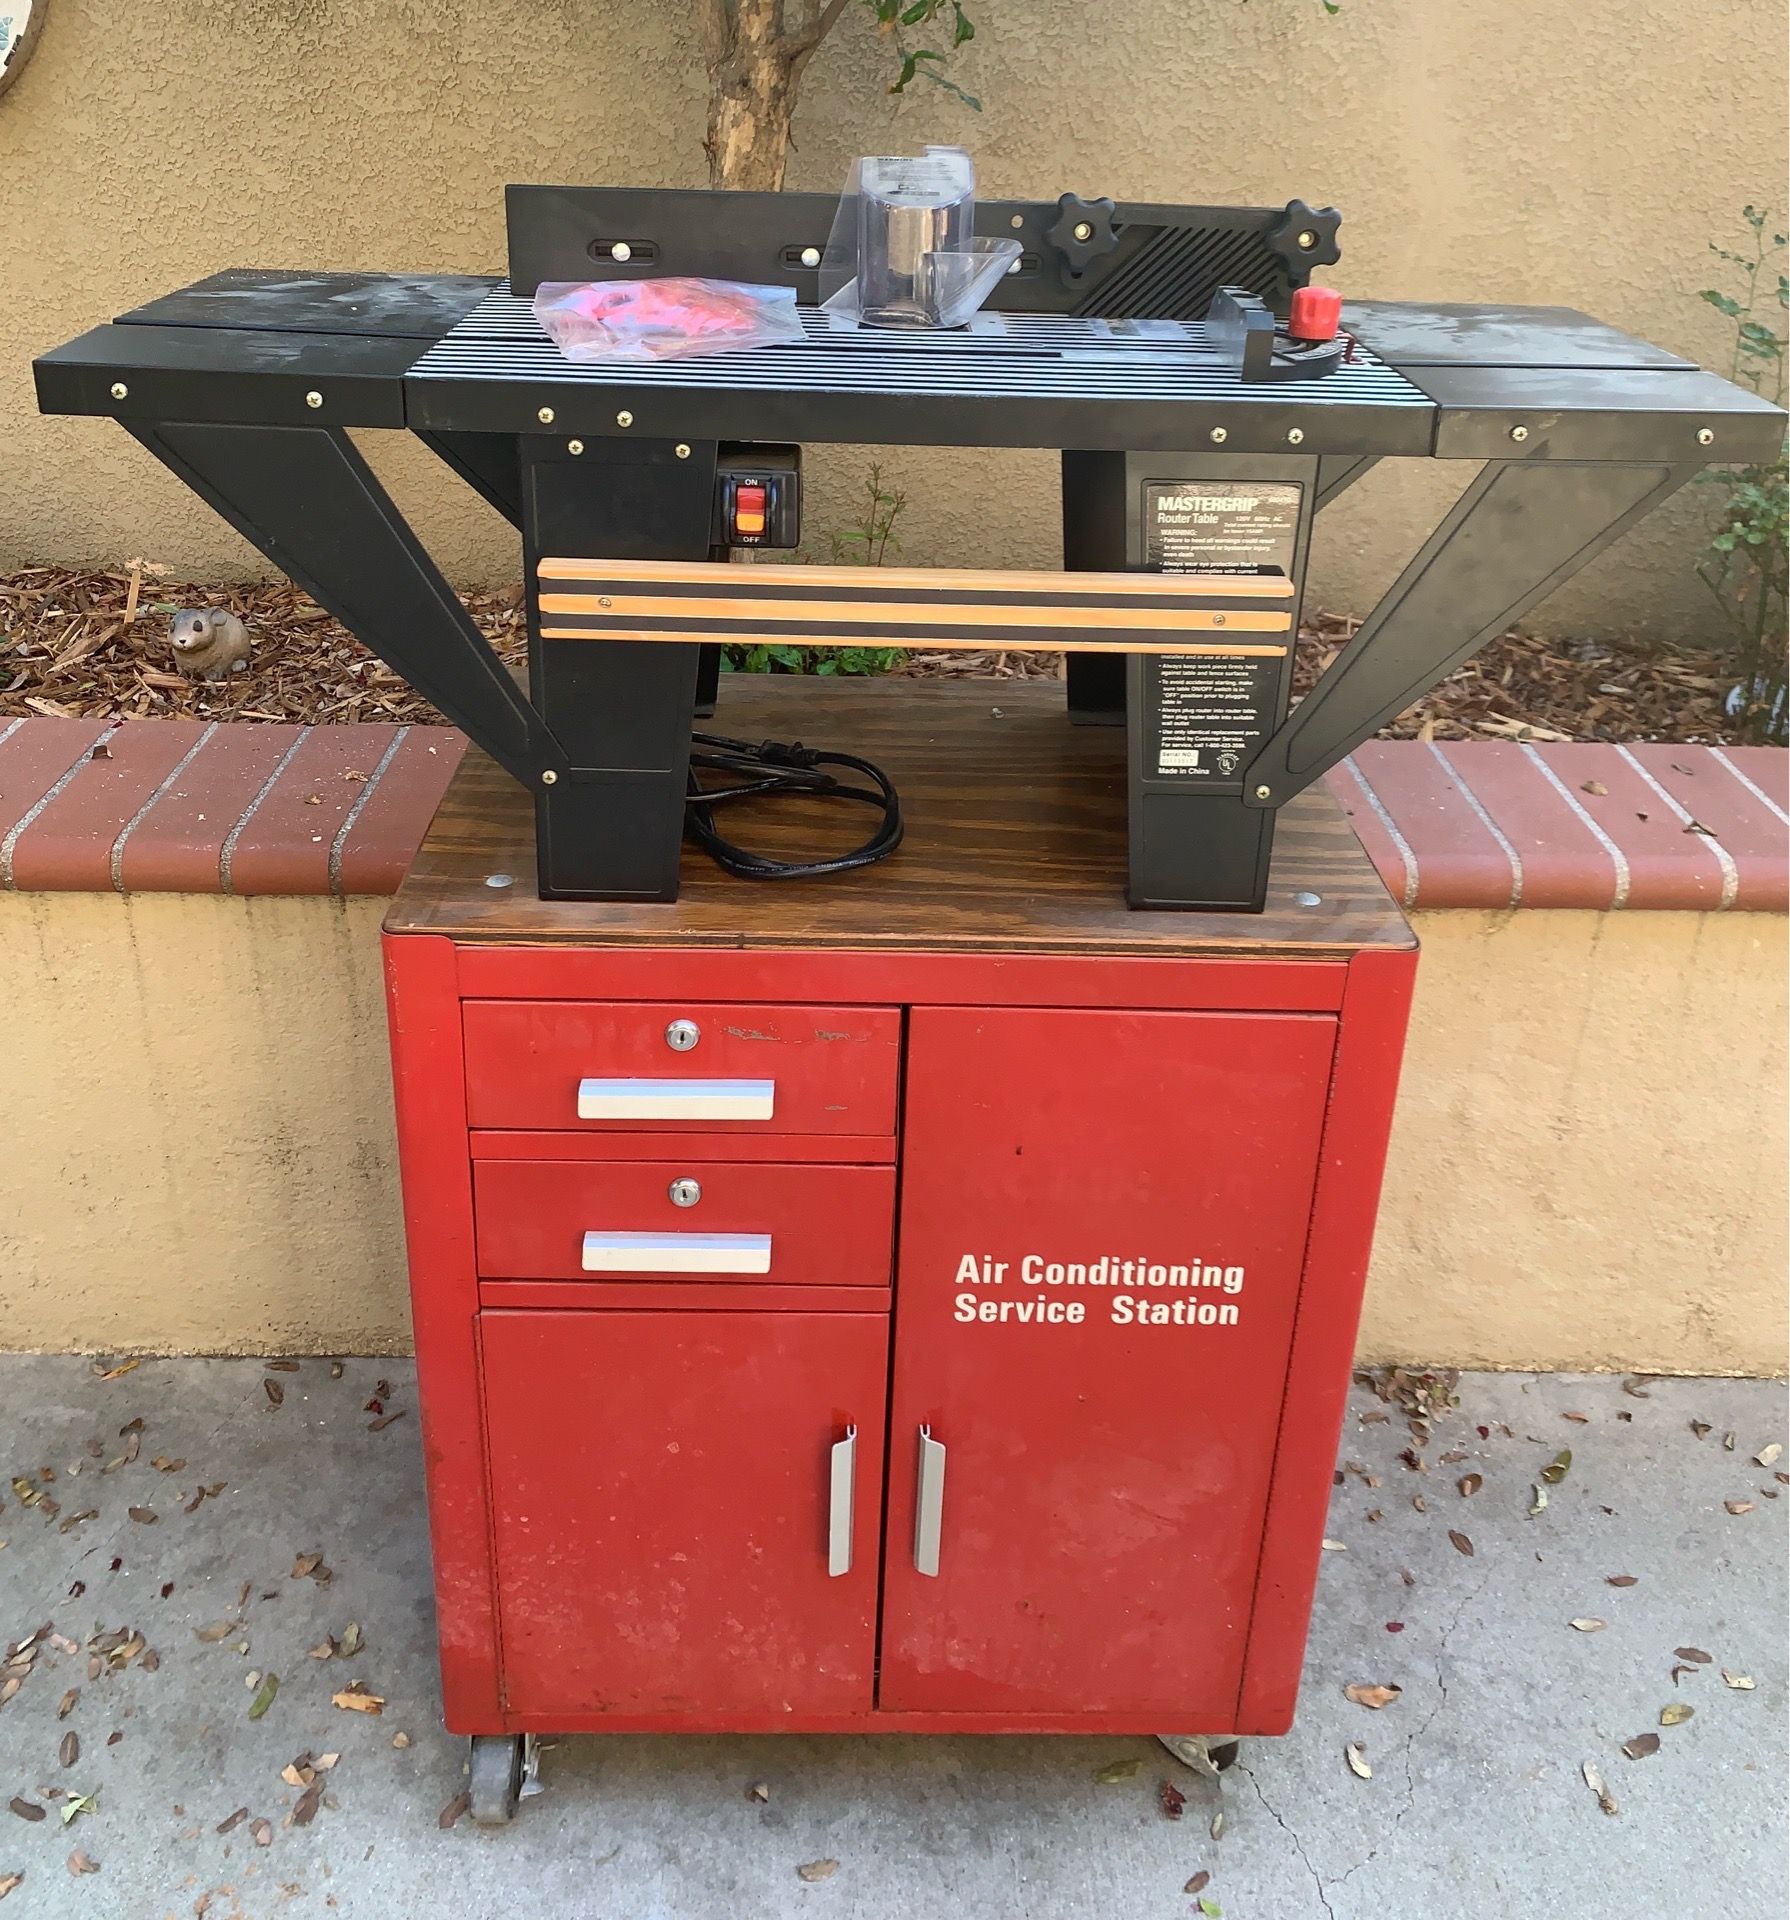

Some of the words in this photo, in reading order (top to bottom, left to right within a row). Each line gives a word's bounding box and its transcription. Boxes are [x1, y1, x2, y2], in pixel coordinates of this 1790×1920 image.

[1158, 496, 1259, 512] MASTERGRIP
[1158, 513, 1191, 524] Router
[1192, 513, 1219, 524] Table
[955, 1254, 1009, 1284] Air
[1021, 1255, 1244, 1294] Conditioning
[954, 1293, 1086, 1323] Service
[1110, 1295, 1240, 1326] Station
